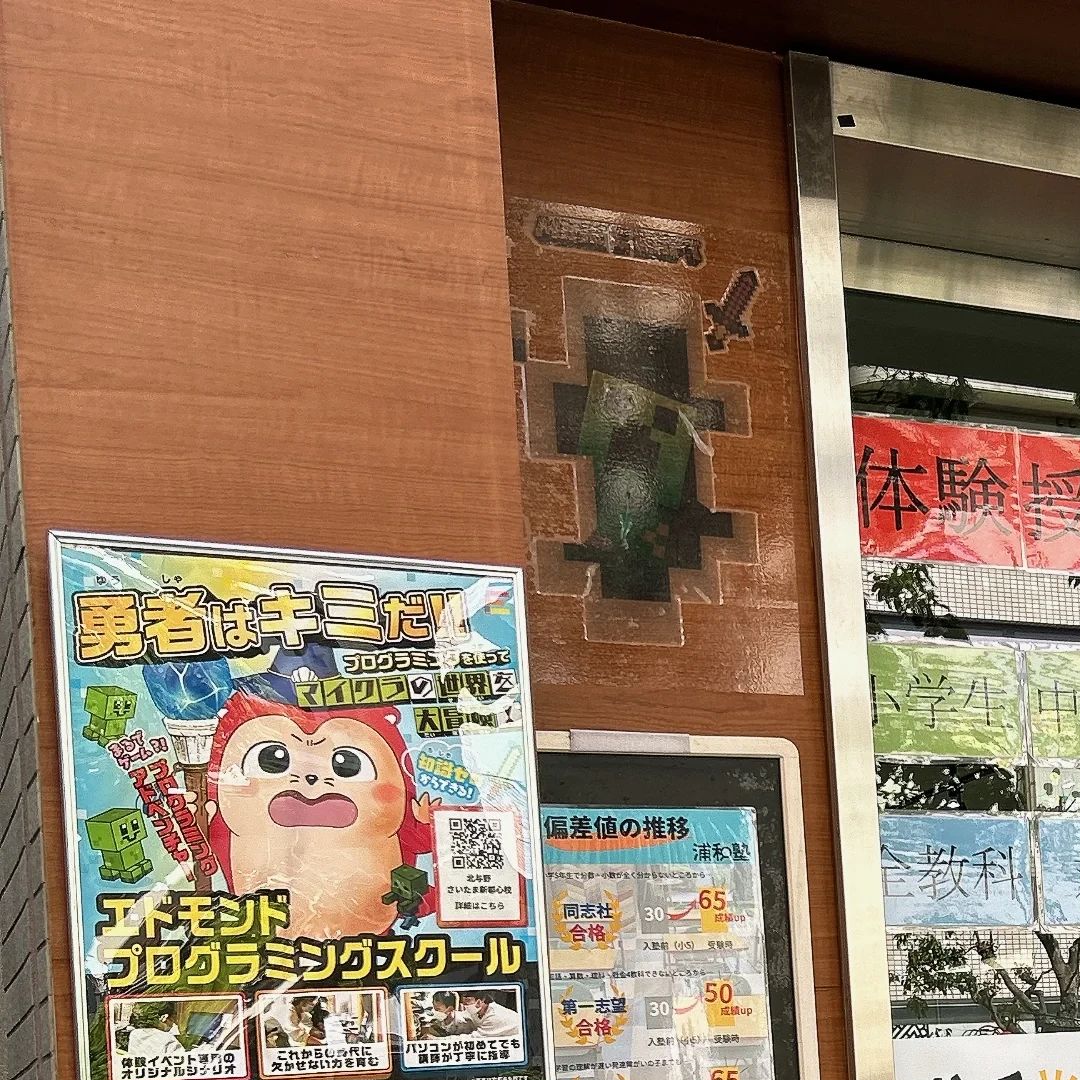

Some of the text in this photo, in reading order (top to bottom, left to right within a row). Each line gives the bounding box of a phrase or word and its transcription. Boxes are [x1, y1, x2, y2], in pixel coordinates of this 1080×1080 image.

[543, 815, 690, 840] 偏差値の推移
[692, 843, 750, 862] 浦和塾
[454, 901, 505, 911] 詳細はこちら
[699, 889, 727, 910] 65
[102, 892, 290, 937] エドモンド
[563, 903, 613, 919] 同志社
[644, 906, 665, 921] 30
[569, 924, 606, 942] 合格
[106, 936, 522, 987] プログラミングスクール
[704, 983, 733, 1004] 50
[561, 997, 627, 1015] 第一志望
[649, 1001, 670, 1016] 30
[575, 1018, 612, 1036] 合格
